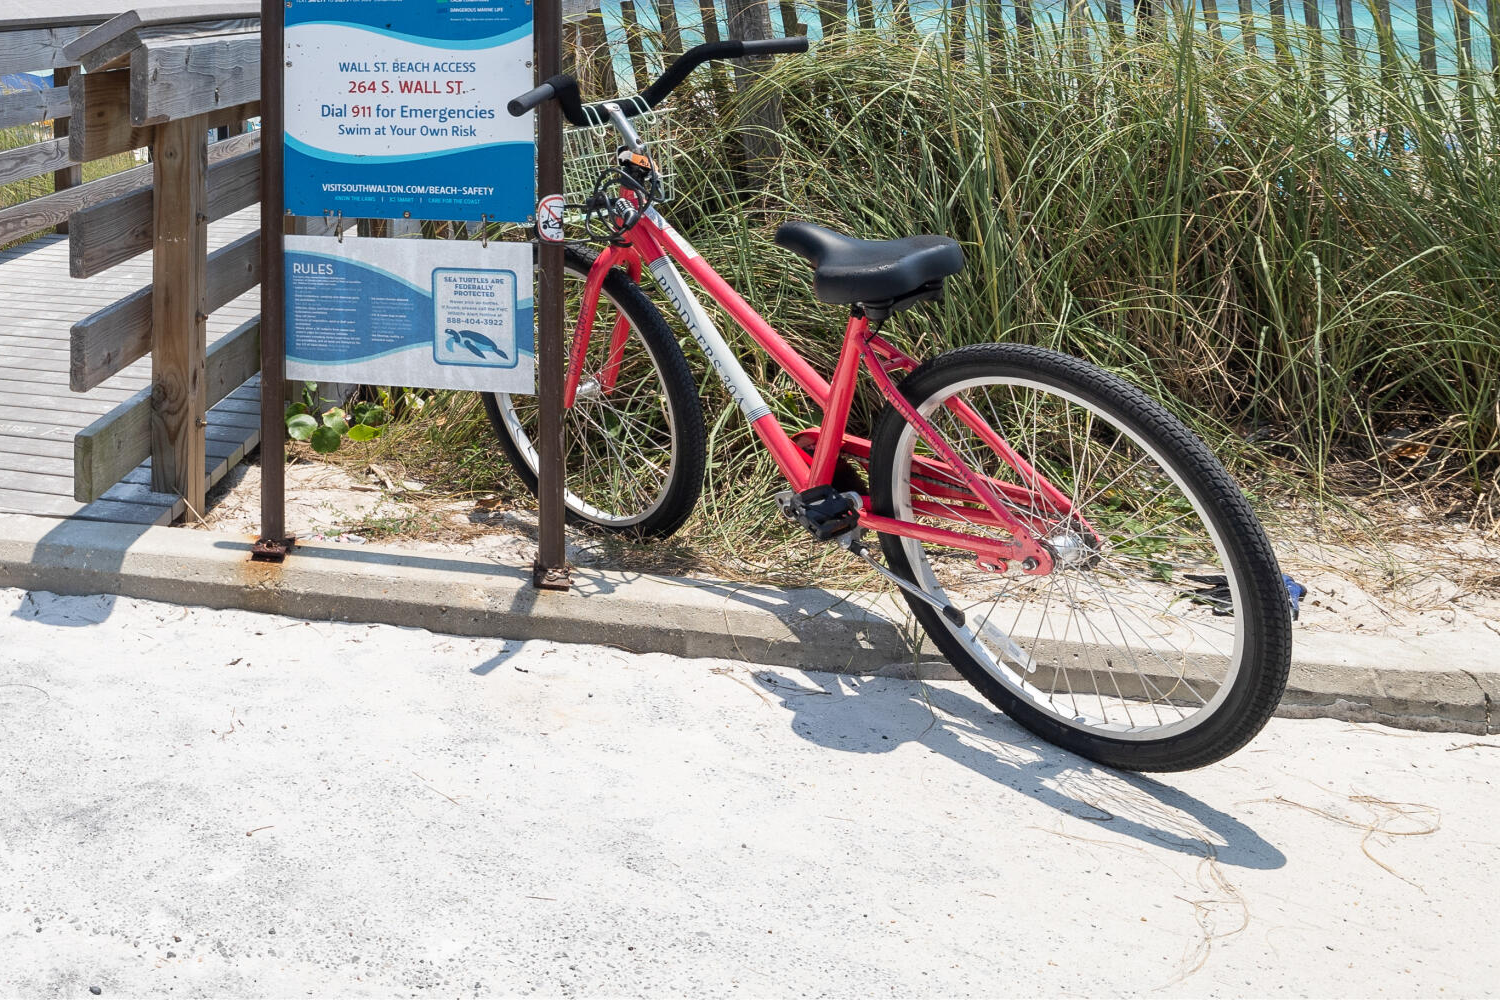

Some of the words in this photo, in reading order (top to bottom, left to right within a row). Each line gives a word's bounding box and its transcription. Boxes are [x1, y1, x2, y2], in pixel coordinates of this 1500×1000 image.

[338, 61, 371, 73] WALL
[373, 61, 390, 73] ST.
[392, 62, 430, 73] BEACH
[433, 62, 476, 73] ACCESS
[348, 80, 377, 94] 264
[381, 80, 394, 94] S.
[399, 80, 441, 94] WALL
[445, 80, 466, 95] ST.
[321, 104, 347, 118] Dial
[351, 105, 372, 118] 911
[376, 104, 396, 118] for
[400, 105, 495, 123] Emergencies
[338, 124, 371, 136] Swim
[374, 125, 387, 136] at
[389, 124, 417, 137] Your
[420, 125, 448, 137] Own
[451, 125, 476, 137] Risk
[322, 183, 494, 196] VISITSOUTHWALTON.COM/BEACH-SAFETY
[293, 263, 333, 275] RULES
[446, 317, 504, 326] 888-404-3922
